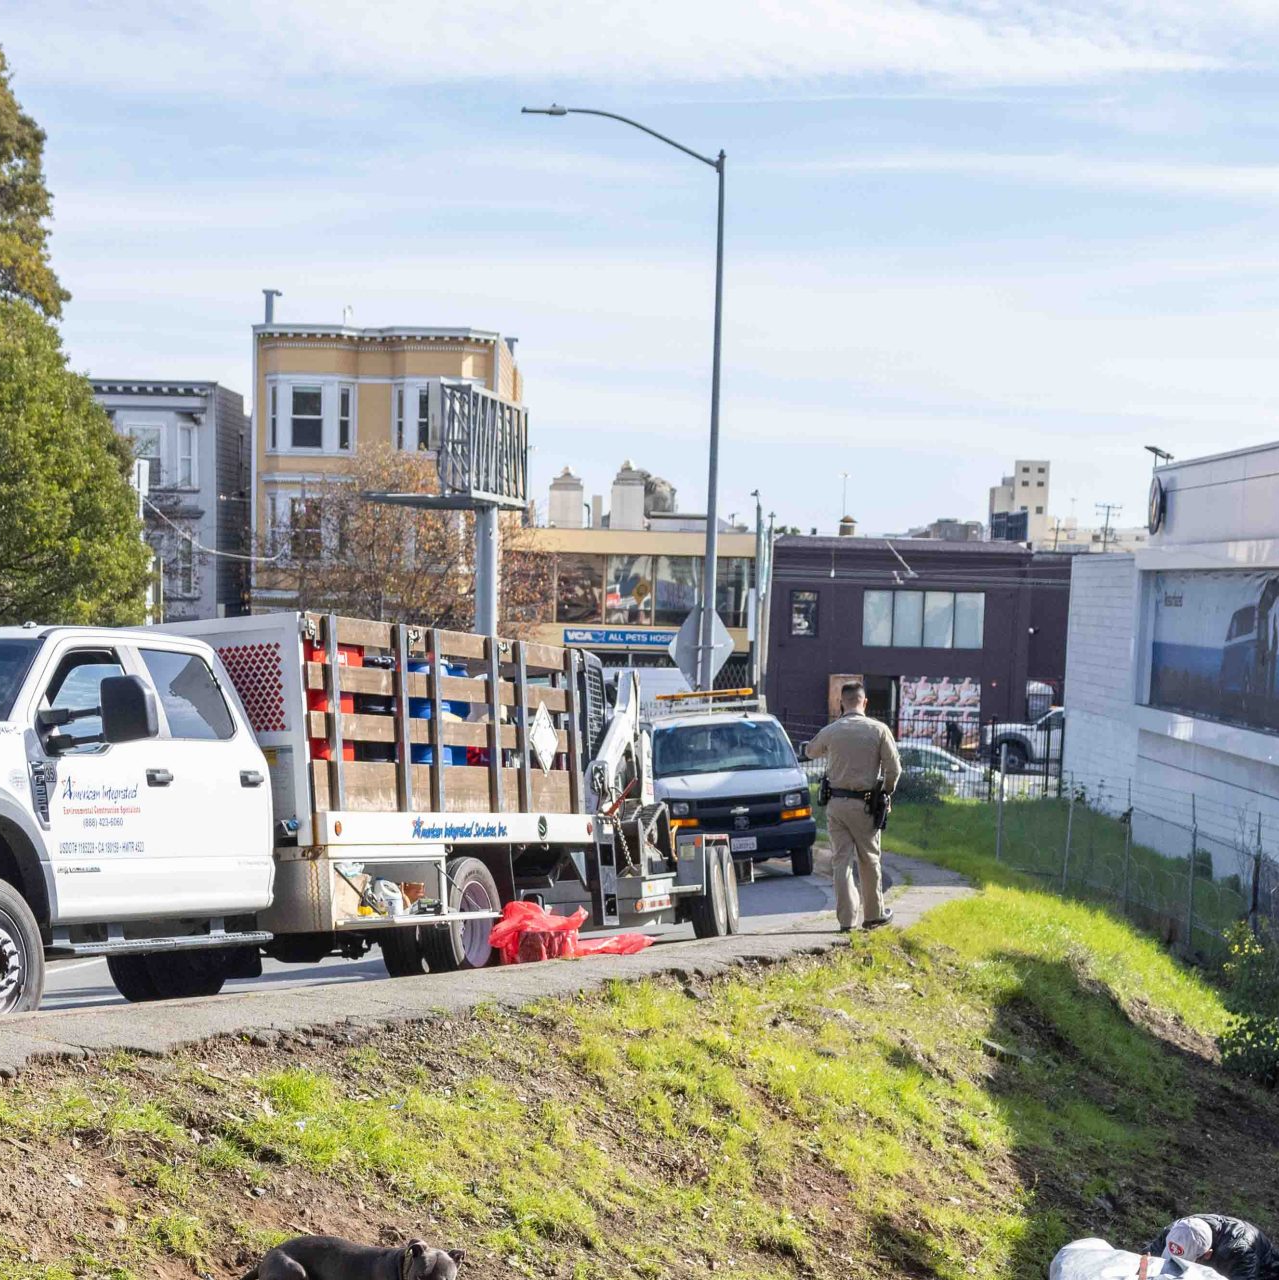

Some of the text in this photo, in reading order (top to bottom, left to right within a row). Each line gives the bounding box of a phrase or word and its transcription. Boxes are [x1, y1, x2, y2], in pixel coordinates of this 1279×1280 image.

[566, 630, 592, 641] VCA
[608, 631, 624, 641] ALL
[625, 632, 648, 641] PETS
[62, 776, 100, 800] American
[102, 783, 139, 804] Integrated
[412, 816, 443, 839] American
[444, 820, 475, 841] Integrated
